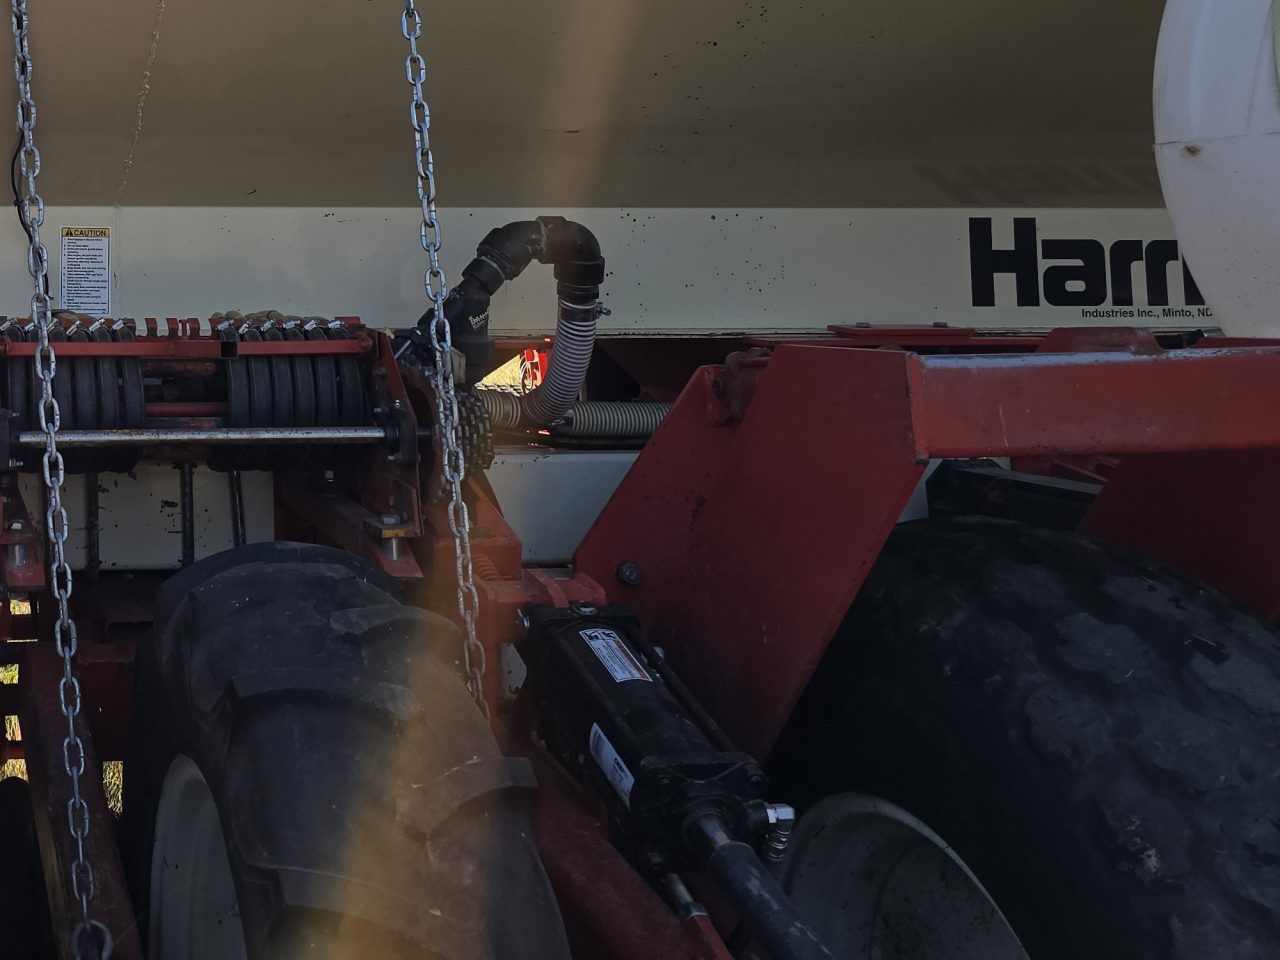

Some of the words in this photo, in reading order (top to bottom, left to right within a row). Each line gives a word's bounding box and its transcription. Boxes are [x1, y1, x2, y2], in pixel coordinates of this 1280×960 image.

[73, 229, 107, 237] CAUTION
[1081, 307, 1134, 318] Industries
[1137, 307, 1160, 319] Inc.,
[1162, 307, 1194, 319] Minto,
